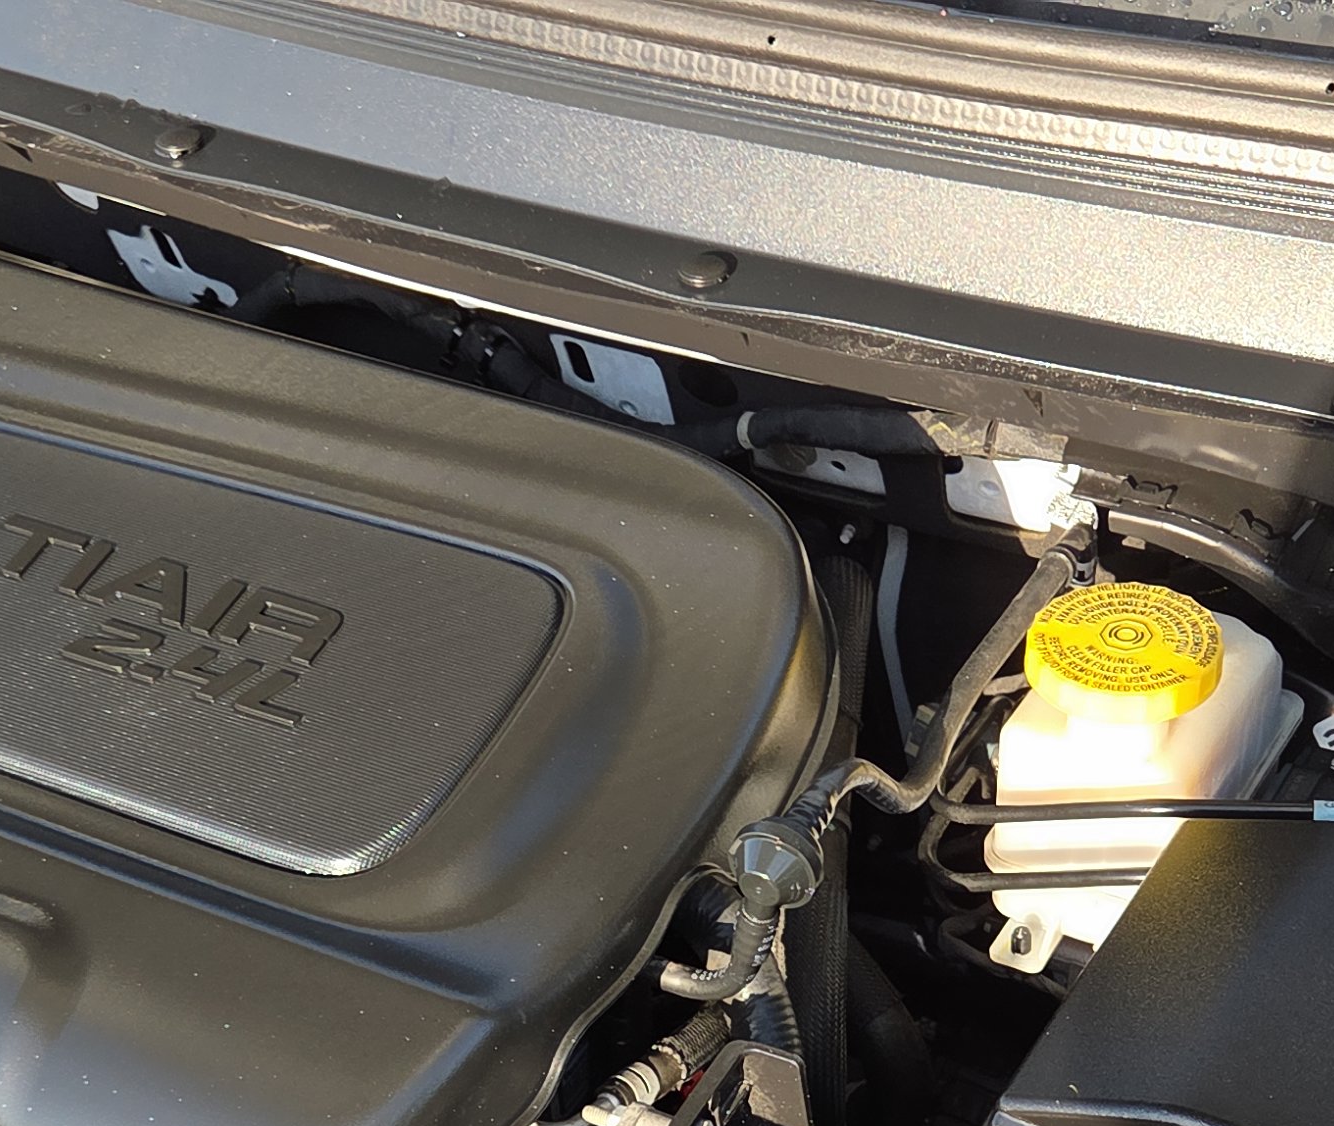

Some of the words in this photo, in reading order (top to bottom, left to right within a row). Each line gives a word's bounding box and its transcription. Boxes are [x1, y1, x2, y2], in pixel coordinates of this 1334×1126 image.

[1075, 597, 1093, 607] DE
[1090, 593, 1104, 602] LE
[1065, 645, 1093, 663] CLEAN
[1089, 661, 1128, 673] FILLER
[1130, 664, 1153, 673] CAP
[63, 618, 307, 728] 2.4L
[1125, 675, 1147, 683] USE
[1148, 668, 1178, 680] ONLY
[1089, 681, 1130, 691] SEALED
[1132, 674, 1190, 691] CONTAINER
